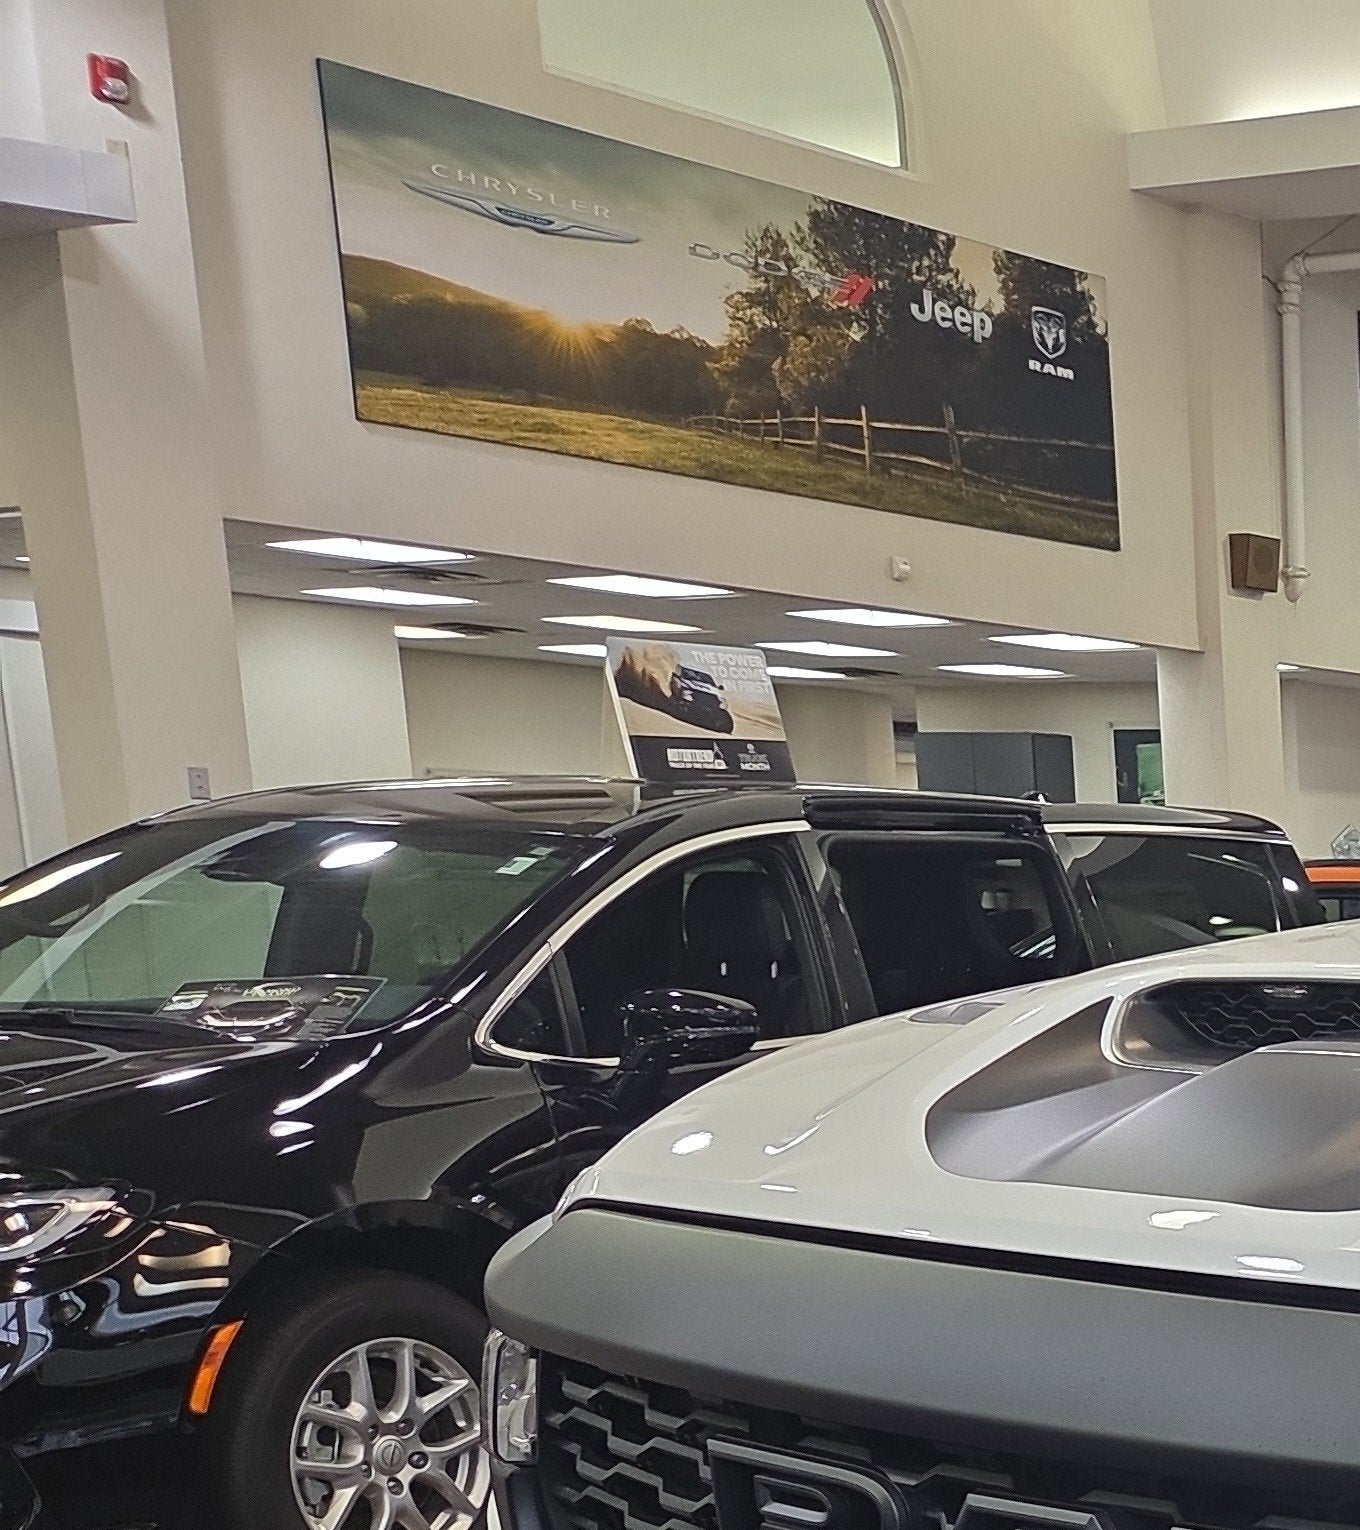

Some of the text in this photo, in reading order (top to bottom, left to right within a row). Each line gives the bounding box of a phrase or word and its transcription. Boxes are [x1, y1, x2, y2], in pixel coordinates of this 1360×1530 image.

[430, 163, 611, 220] CHRYSLER
[910, 288, 993, 344] Jeep
[1028, 358, 1075, 381] RAM
